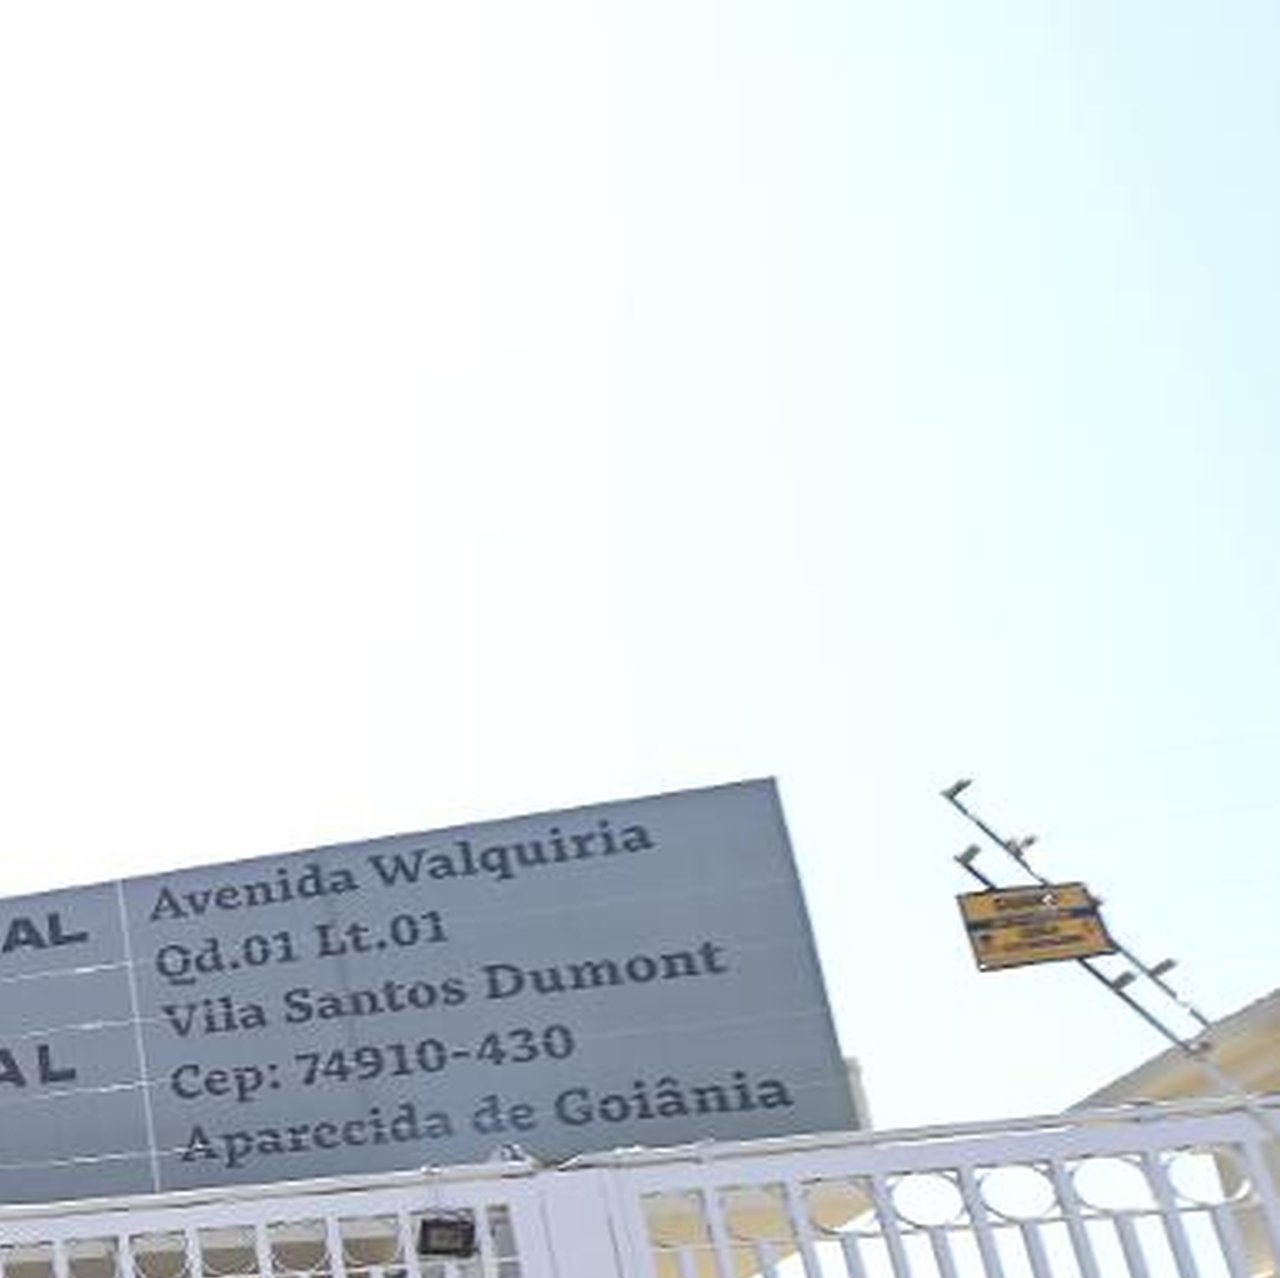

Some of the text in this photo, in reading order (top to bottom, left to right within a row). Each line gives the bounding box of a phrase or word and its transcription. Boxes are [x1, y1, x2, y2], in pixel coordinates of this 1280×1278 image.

[148, 819, 655, 922] Avenida Walquiria
[155, 910, 449, 986] Qd.01 Lt.01
[164, 938, 728, 1040] Vila Santos Dumont
[170, 1023, 576, 1104] Cep: 74910-430
[181, 1072, 795, 1170] Aparecida de Goiânia
